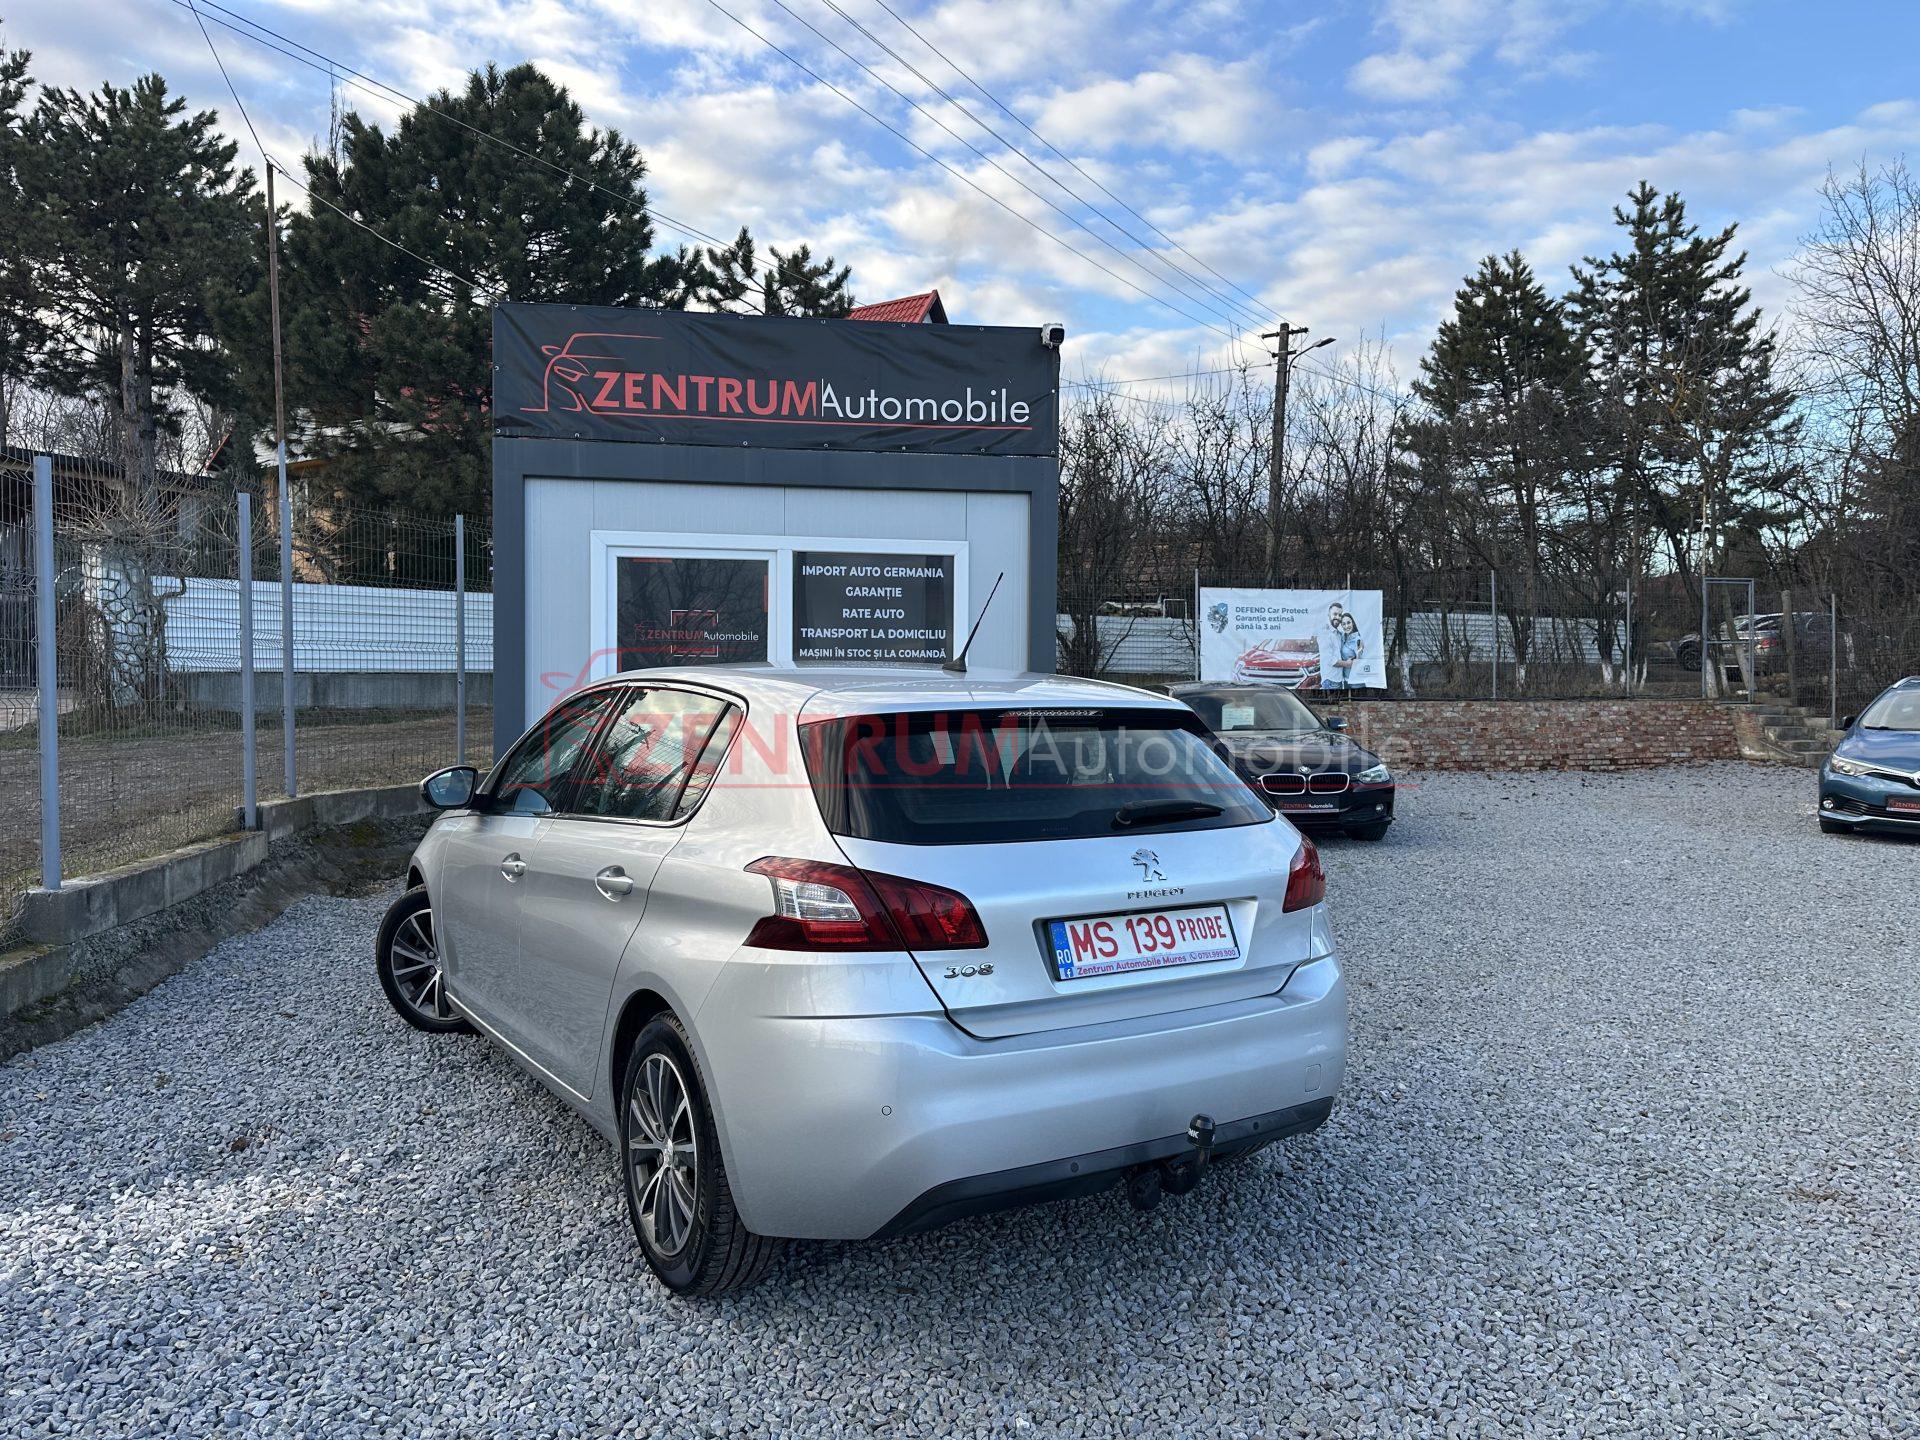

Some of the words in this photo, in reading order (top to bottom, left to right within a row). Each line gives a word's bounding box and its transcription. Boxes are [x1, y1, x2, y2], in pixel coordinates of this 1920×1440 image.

[591, 371, 817, 416] ZENTRUM
[822, 383, 1031, 423] Automobile
[802, 565, 847, 576] IMPORT
[849, 566, 881, 577] AUTO
[884, 567, 944, 578] GERMANIA
[845, 586, 903, 600] GARANȚIE
[842, 608, 871, 618] RATE
[873, 608, 905, 619] AUTO
[1235, 606, 1266, 614] DEFEND
[647, 629, 704, 640] ZENTRUM
[704, 631, 759, 641] Automobile
[800, 628, 868, 638] TRANSPORT
[871, 629, 885, 639] LA
[888, 629, 946, 639] DOMICILIU
[799, 648, 833, 659] MAȘINI
[835, 647, 845, 657] ÎN
[847, 648, 871, 658] STOC
[873, 648, 882, 659] ȘI
[884, 649, 896, 658] LA
[898, 648, 947, 658] COMANDĂ
[1127, 887, 1186, 900] PEUGEOT
[1056, 949, 1072, 965] RO
[1069, 921, 1119, 962] MS
[1125, 915, 1176, 954] 139
[1176, 916, 1227, 942] PROBE
[944, 962, 995, 979] 308
[1077, 964, 1114, 975] Zentrum
[1116, 957, 1161, 971] Automobile
